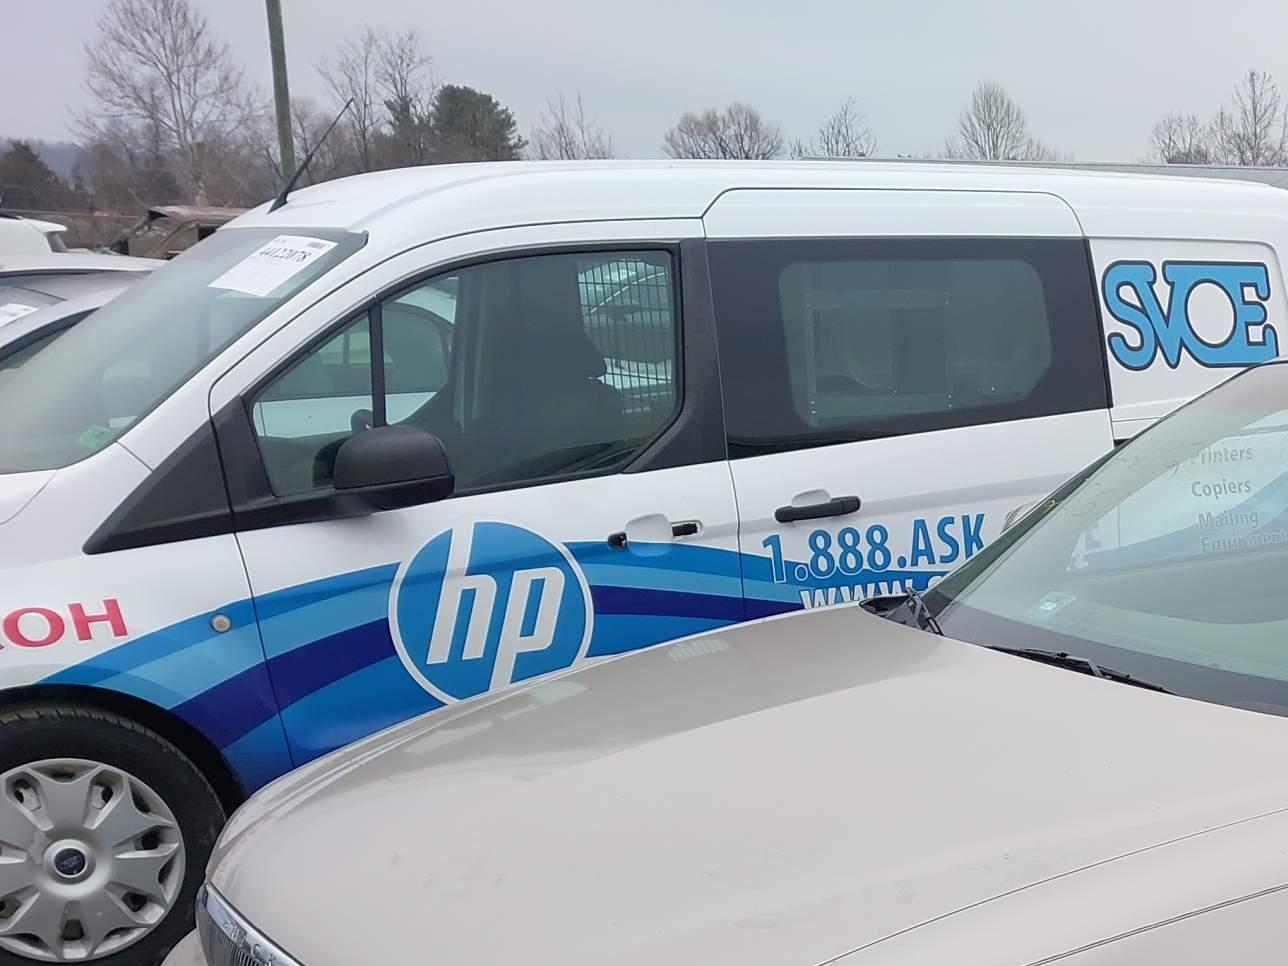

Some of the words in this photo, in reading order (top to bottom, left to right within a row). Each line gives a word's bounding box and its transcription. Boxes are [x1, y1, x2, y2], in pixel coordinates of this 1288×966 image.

[1101, 259, 1280, 371] SVOE
[1191, 477, 1252, 500] Copiers
[1198, 508, 1259, 528] Mailing
[0, 597, 128, 650] OH
[426, 522, 566, 690] hp
